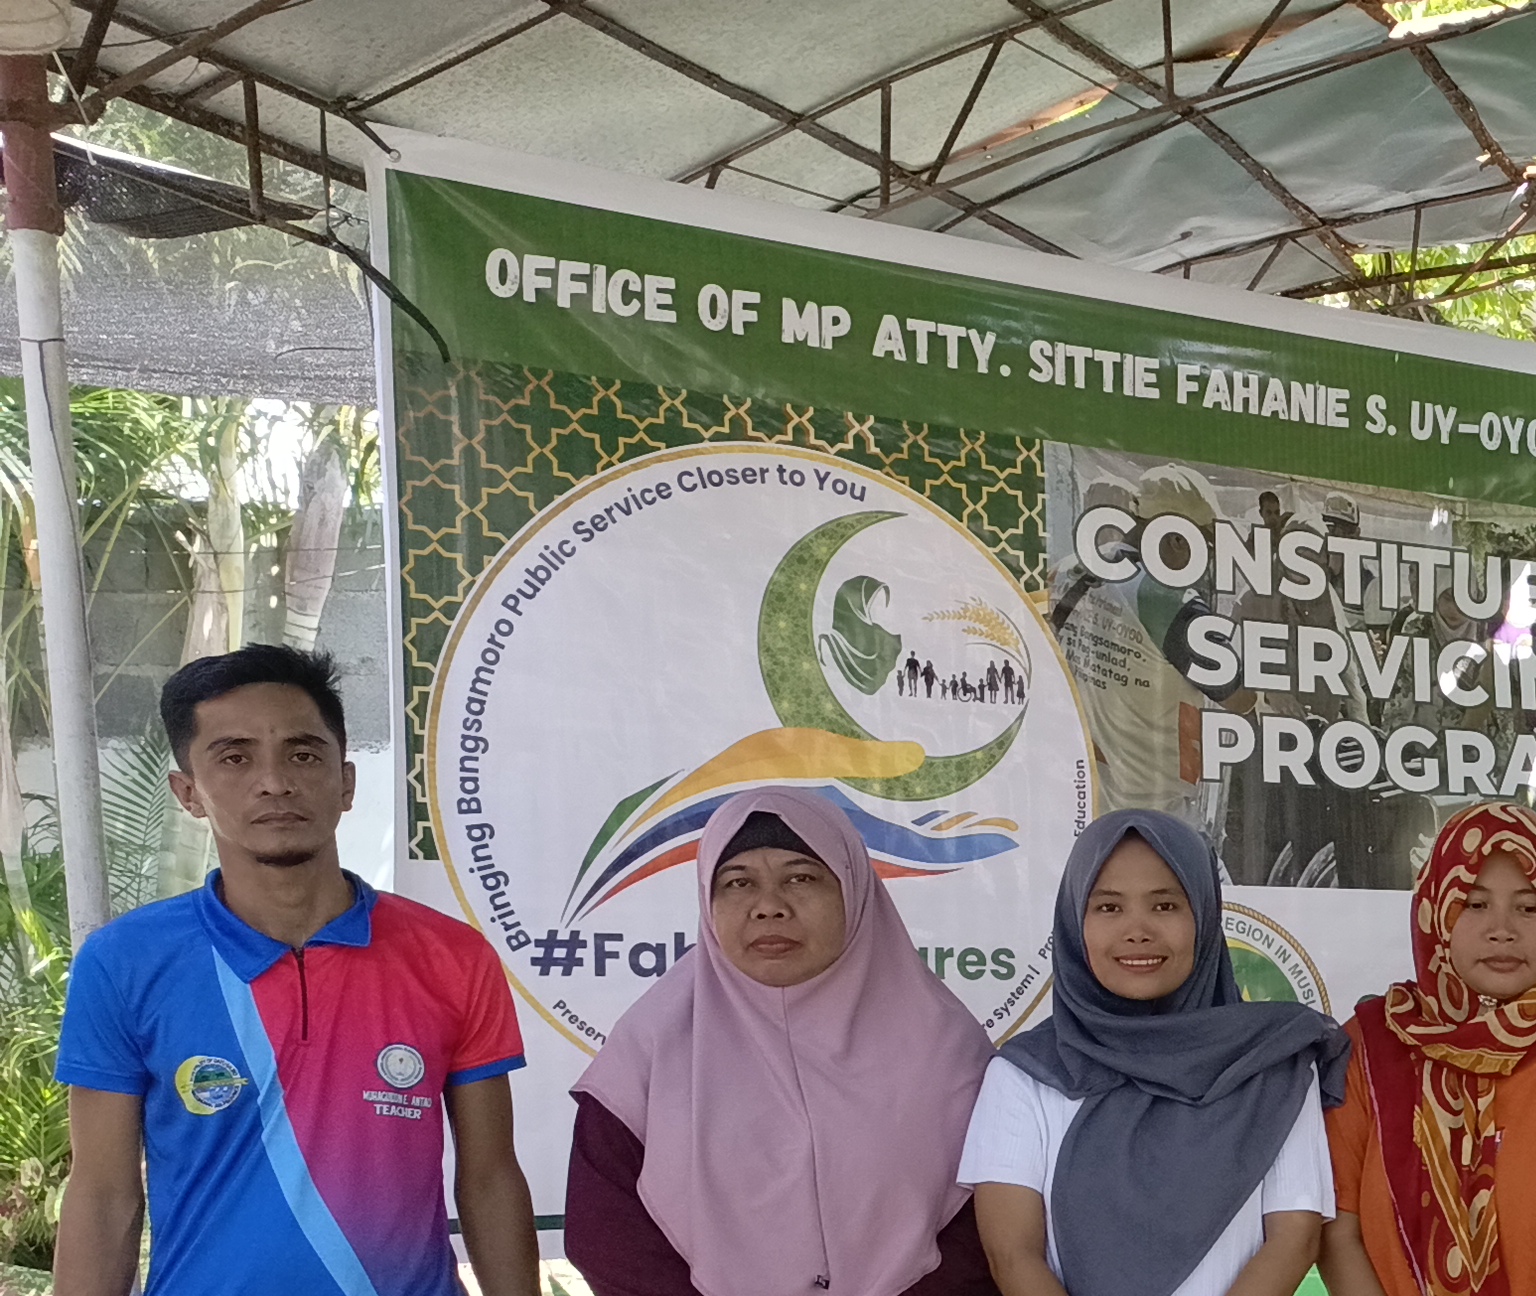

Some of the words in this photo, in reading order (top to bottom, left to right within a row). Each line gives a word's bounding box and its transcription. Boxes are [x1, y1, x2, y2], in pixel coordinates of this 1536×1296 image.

[484, 247, 678, 324] OFFICE
[697, 282, 762, 337] OF
[780, 298, 853, 351] MP
[871, 315, 1012, 378] ATTY.
[1028, 339, 1161, 400] SITTIE
[1177, 363, 1350, 429] FAHANIE
[1365, 394, 1397, 437] S.
[676, 463, 770, 493] Closer
[776, 463, 807, 488] to
[813, 468, 868, 502] You
[571, 479, 674, 543] Service
[500, 538, 578, 618] Public
[457, 619, 515, 815] Bangsamoro
[1074, 759, 1086, 838] Education
[465, 821, 532, 952] Bringing
[1274, 944, 1292, 964] IN
[992, 973, 1034, 1020] System
[373, 1104, 422, 1120] TEACHER
